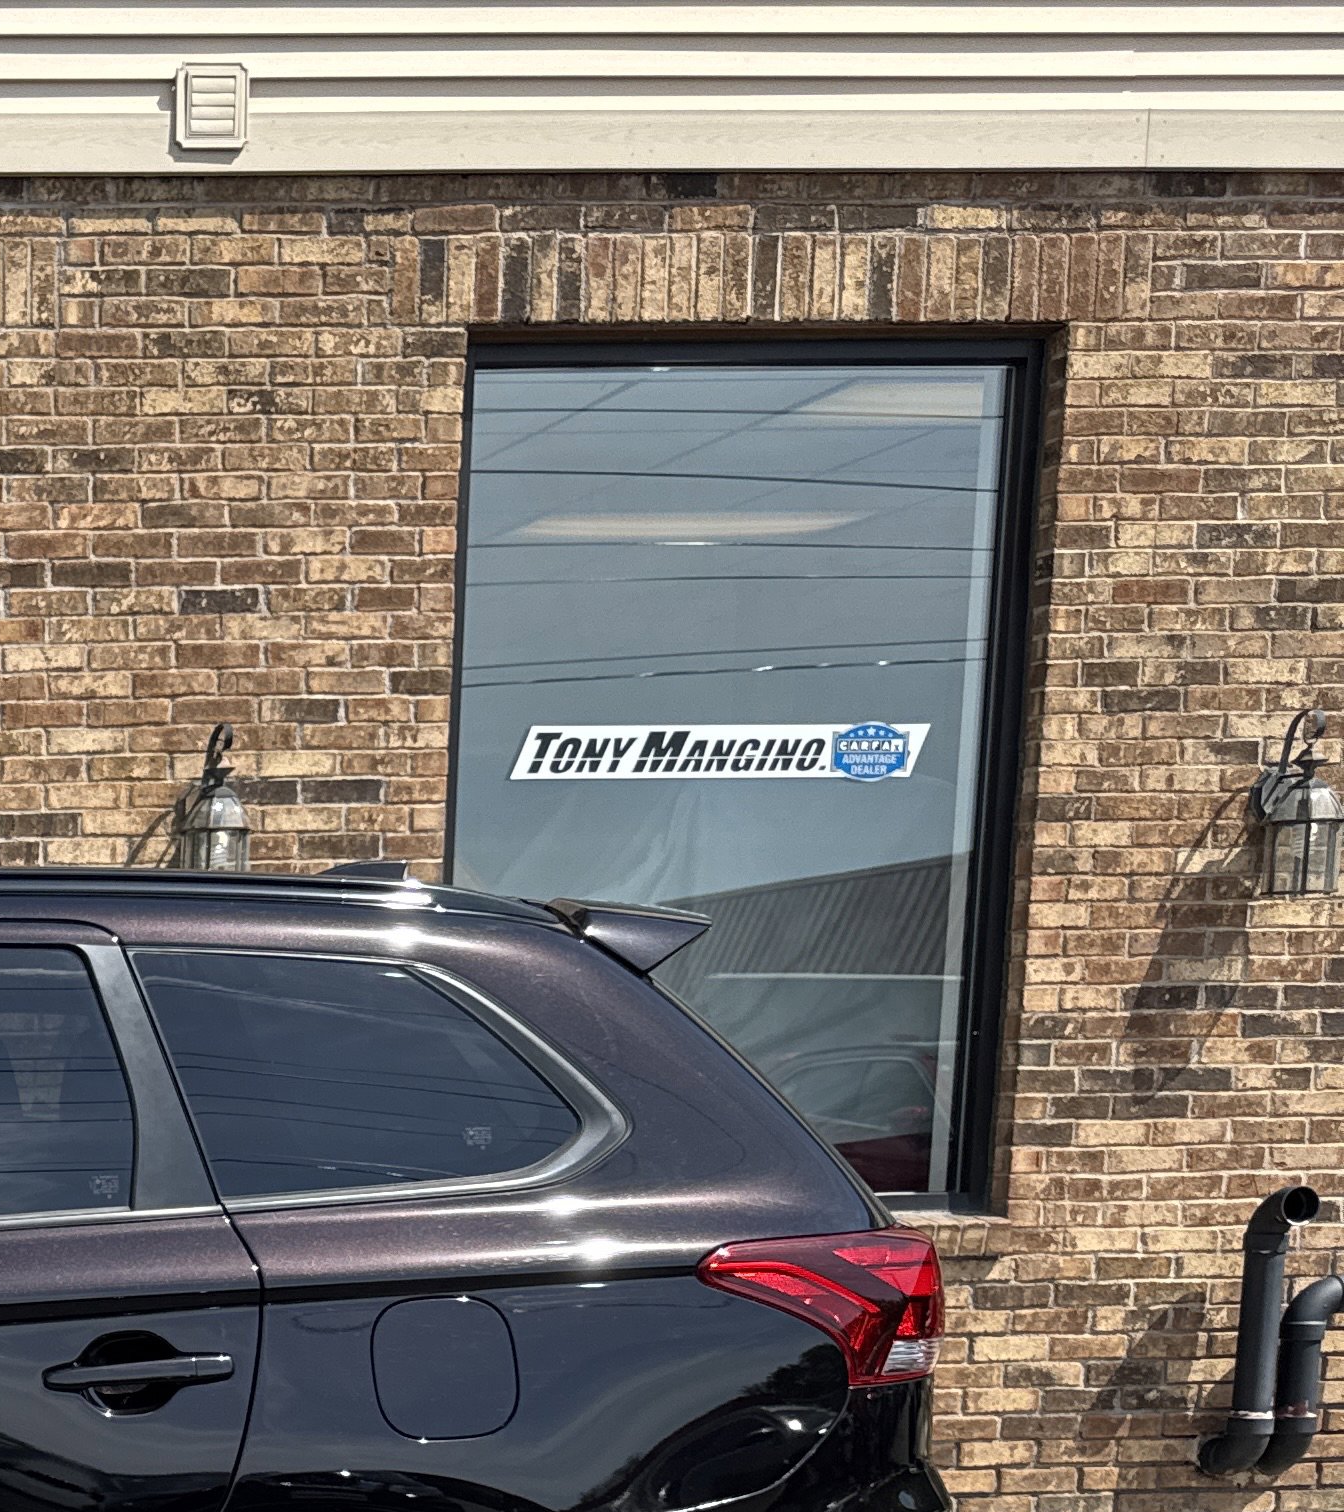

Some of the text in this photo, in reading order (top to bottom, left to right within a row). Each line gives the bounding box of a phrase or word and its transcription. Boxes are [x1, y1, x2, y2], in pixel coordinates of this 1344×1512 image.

[837, 738, 904, 753] CARFAX
[841, 752, 899, 766] ADVANTAGE
[850, 764, 888, 776] DEALER
